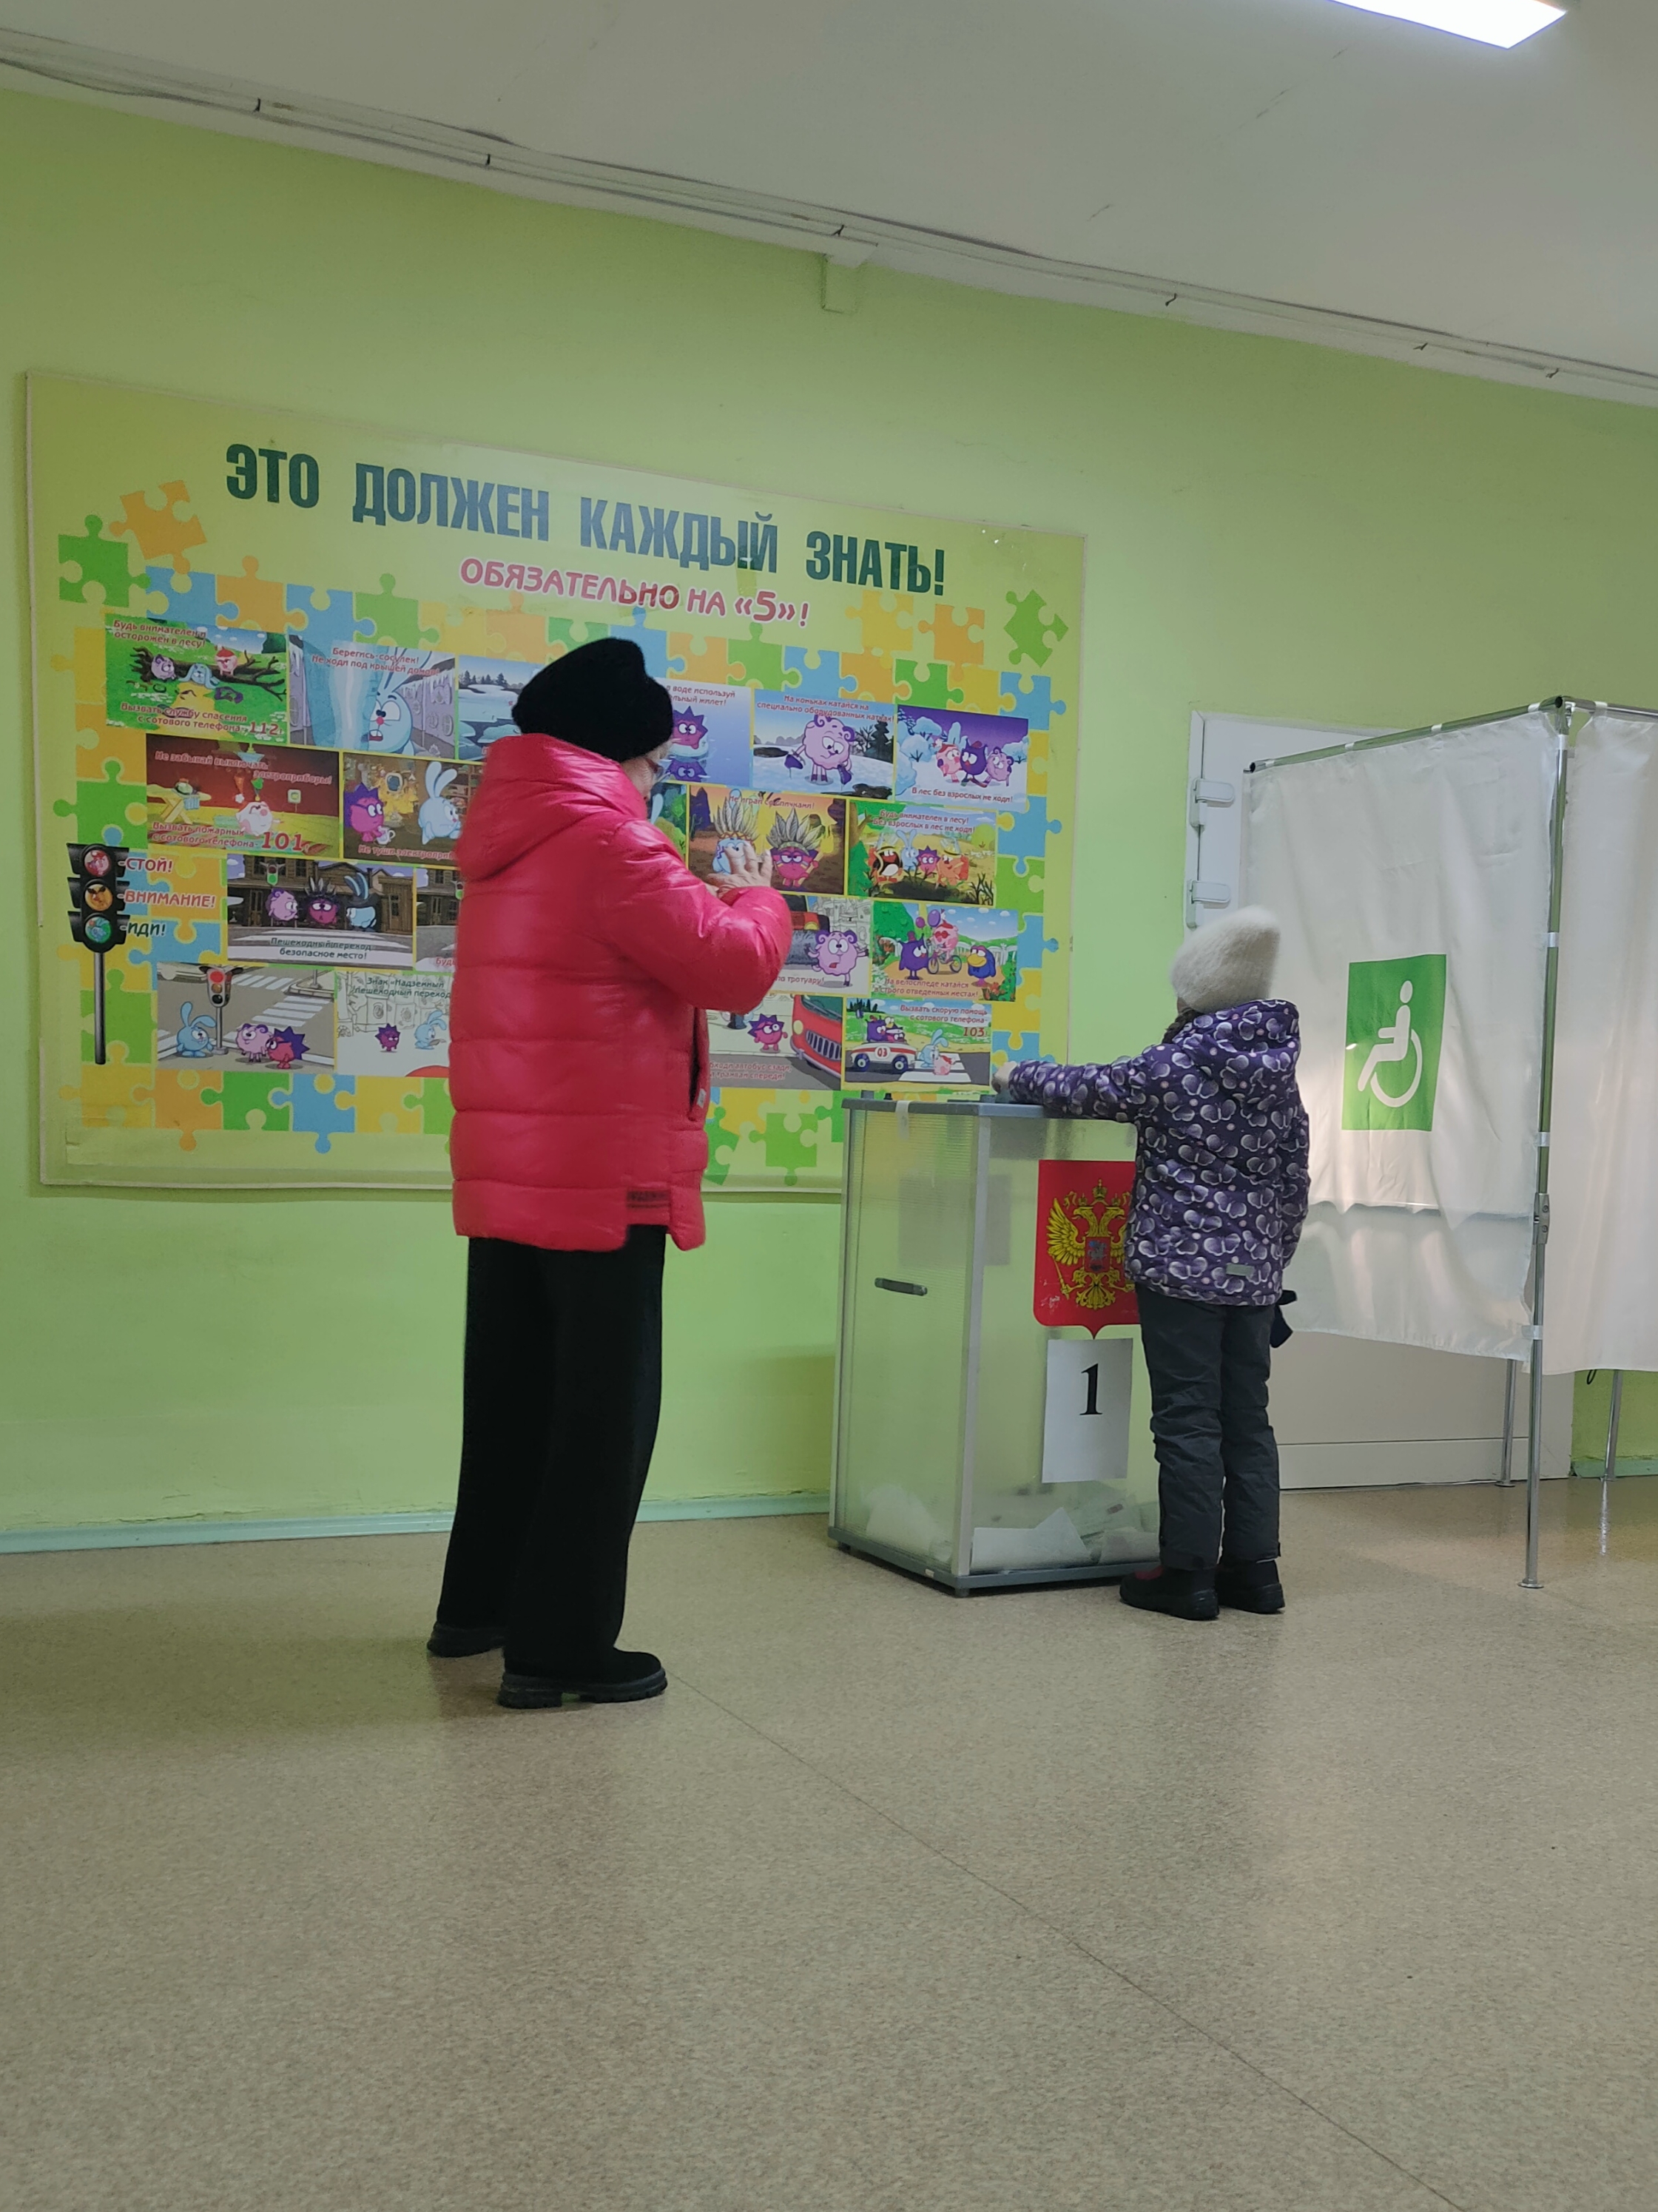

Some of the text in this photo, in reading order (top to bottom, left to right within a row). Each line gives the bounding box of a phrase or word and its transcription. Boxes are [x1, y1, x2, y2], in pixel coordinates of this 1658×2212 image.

[226, 443, 946, 596] ЭТО ДОЛЖЕН КАЖДЫЙ ЗНАТЬ!
[460, 558, 679, 610] ОБЯЗАТЕЛЬНО
[687, 587, 727, 616] НА
[113, 619, 137, 631] Будь
[140, 624, 200, 637] внимателен
[115, 631, 169, 644] осторожен
[179, 638, 206, 648] лесу!
[333, 647, 419, 664] Берегись сосулек!
[311, 655, 324, 664] Не
[326, 657, 348, 667] ходи
[351, 660, 368, 670] под
[370, 662, 405, 672] крышей
[694, 688, 735, 699] используй
[698, 698, 727, 707] жилет!
[795, 697, 826, 707] коньках
[829, 700, 858, 710] катайся
[121, 703, 247, 722] Вызвать службу спасения
[757, 702, 803, 712] специально
[804, 707, 865, 720] оборудованных
[146, 716, 191, 727] сотового
[155, 750, 169, 761] Не
[933, 789, 946, 798] без
[948, 792, 981, 800] взрослых
[993, 795, 1013, 803] ходи!
[900, 812, 943, 823] внимателен
[949, 816, 969, 824] лесу!
[152, 821, 244, 837] Вызвать пожарных
[888, 820, 923, 829] взрослых
[161, 834, 204, 844] сотового
[271, 937, 331, 948] Пешеходный
[279, 947, 367, 960] безопасное место!
[366, 977, 388, 986] Знак
[896, 979, 939, 988] велосипеде
[900, 1005, 930, 1013] Вызвать
[931, 1007, 959, 1015] скорую
[877, 1048, 888, 1058] 03
[709, 1061, 733, 1070] бходи
[1079, 1363, 1103, 1416] 1
